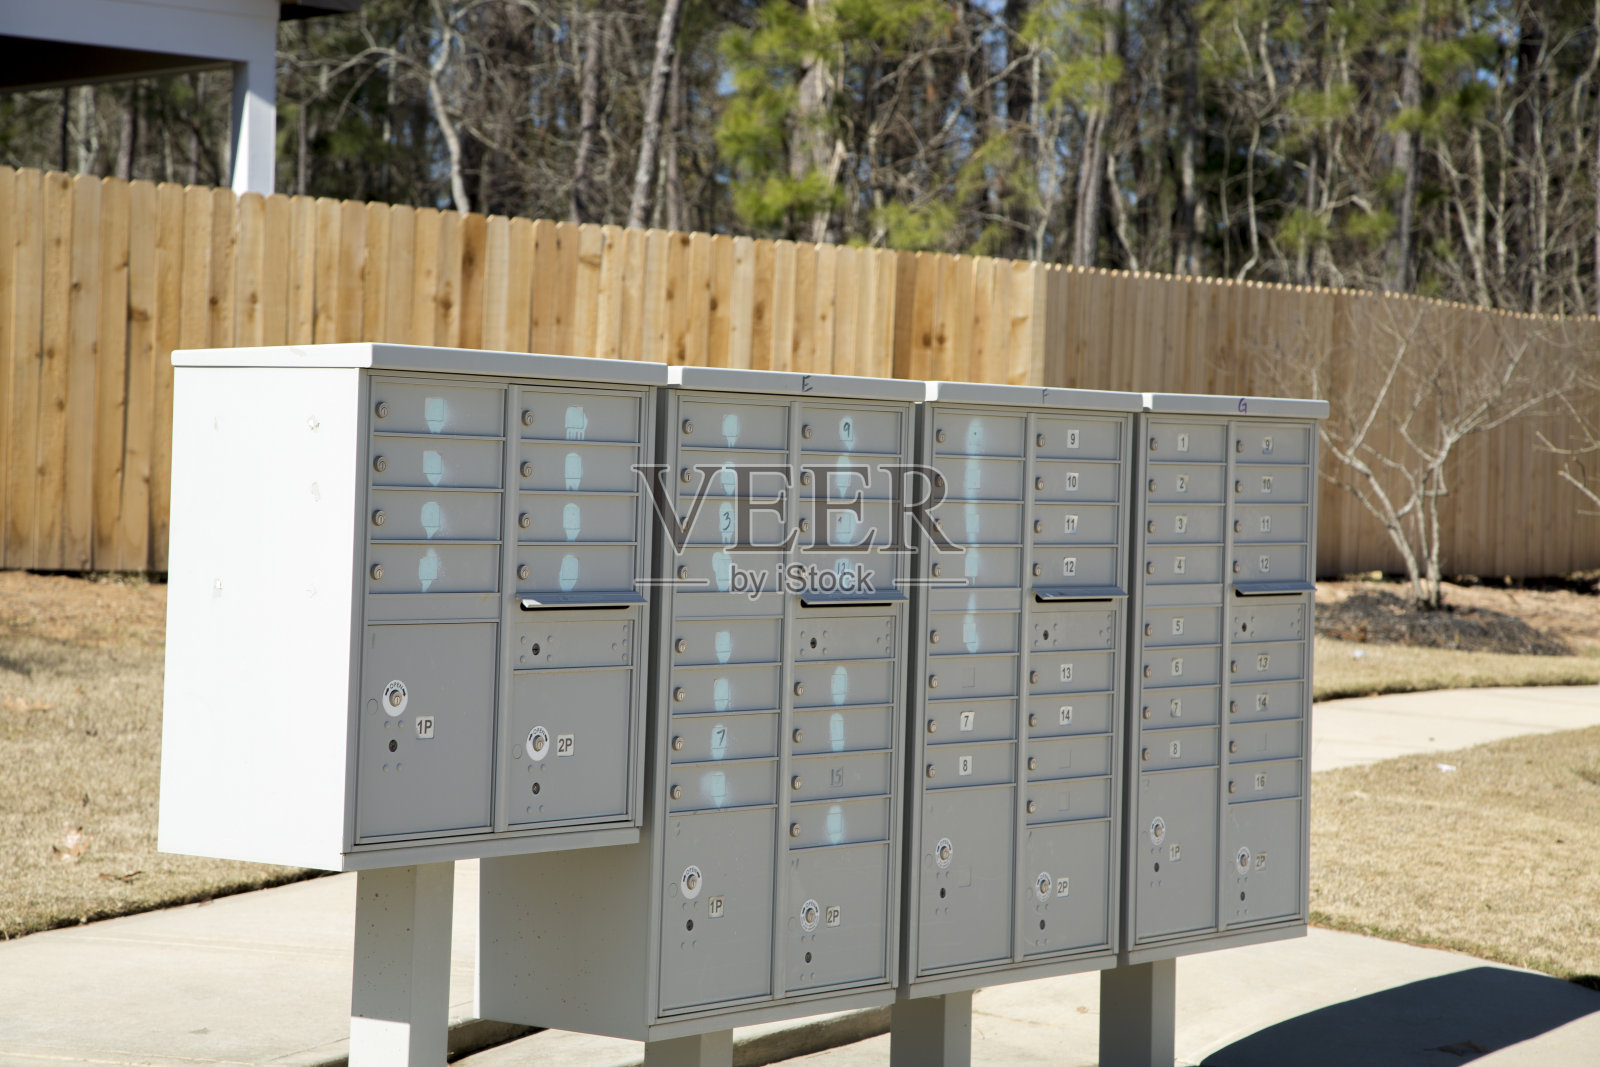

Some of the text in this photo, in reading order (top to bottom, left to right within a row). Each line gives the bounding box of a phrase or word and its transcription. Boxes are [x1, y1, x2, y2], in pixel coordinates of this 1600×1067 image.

[802, 375, 813, 392] E
[1042, 388, 1049, 404] F
[1238, 398, 1247, 414] G
[843, 421, 851, 438] 9
[1070, 433, 1076, 445] 9
[1265, 439, 1270, 450] 9
[1068, 476, 1077, 488] 10
[1179, 477, 1184, 489] 2
[1263, 478, 1271, 490] 10
[722, 511, 731, 531] 3
[1066, 518, 1075, 530] 11
[1178, 518, 1183, 530] 3
[1262, 519, 1269, 530] 11
[1065, 561, 1074, 573] 12
[1177, 559, 1182, 570] 4
[1261, 558, 1268, 569] 12
[1176, 620, 1181, 632] 5
[1175, 661, 1179, 672] 6
[1259, 656, 1267, 668] 13
[1062, 667, 1071, 679] 13
[389, 681, 404, 690] OPEN
[1174, 702, 1178, 713] 7
[1258, 697, 1267, 708] 14
[964, 715, 970, 727] 7
[1061, 709, 1070, 721] 14
[417, 719, 432, 735] 1P
[716, 729, 725, 746] 7
[558, 738, 572, 753] 2P
[1173, 743, 1178, 754] 8
[962, 760, 968, 772] 8
[1257, 776, 1264, 787] 16
[1171, 845, 1180, 857] 1P
[1256, 855, 1265, 867] 2P
[1057, 881, 1067, 894] 2P
[710, 900, 722, 914] 1P
[827, 909, 839, 923] 2P
